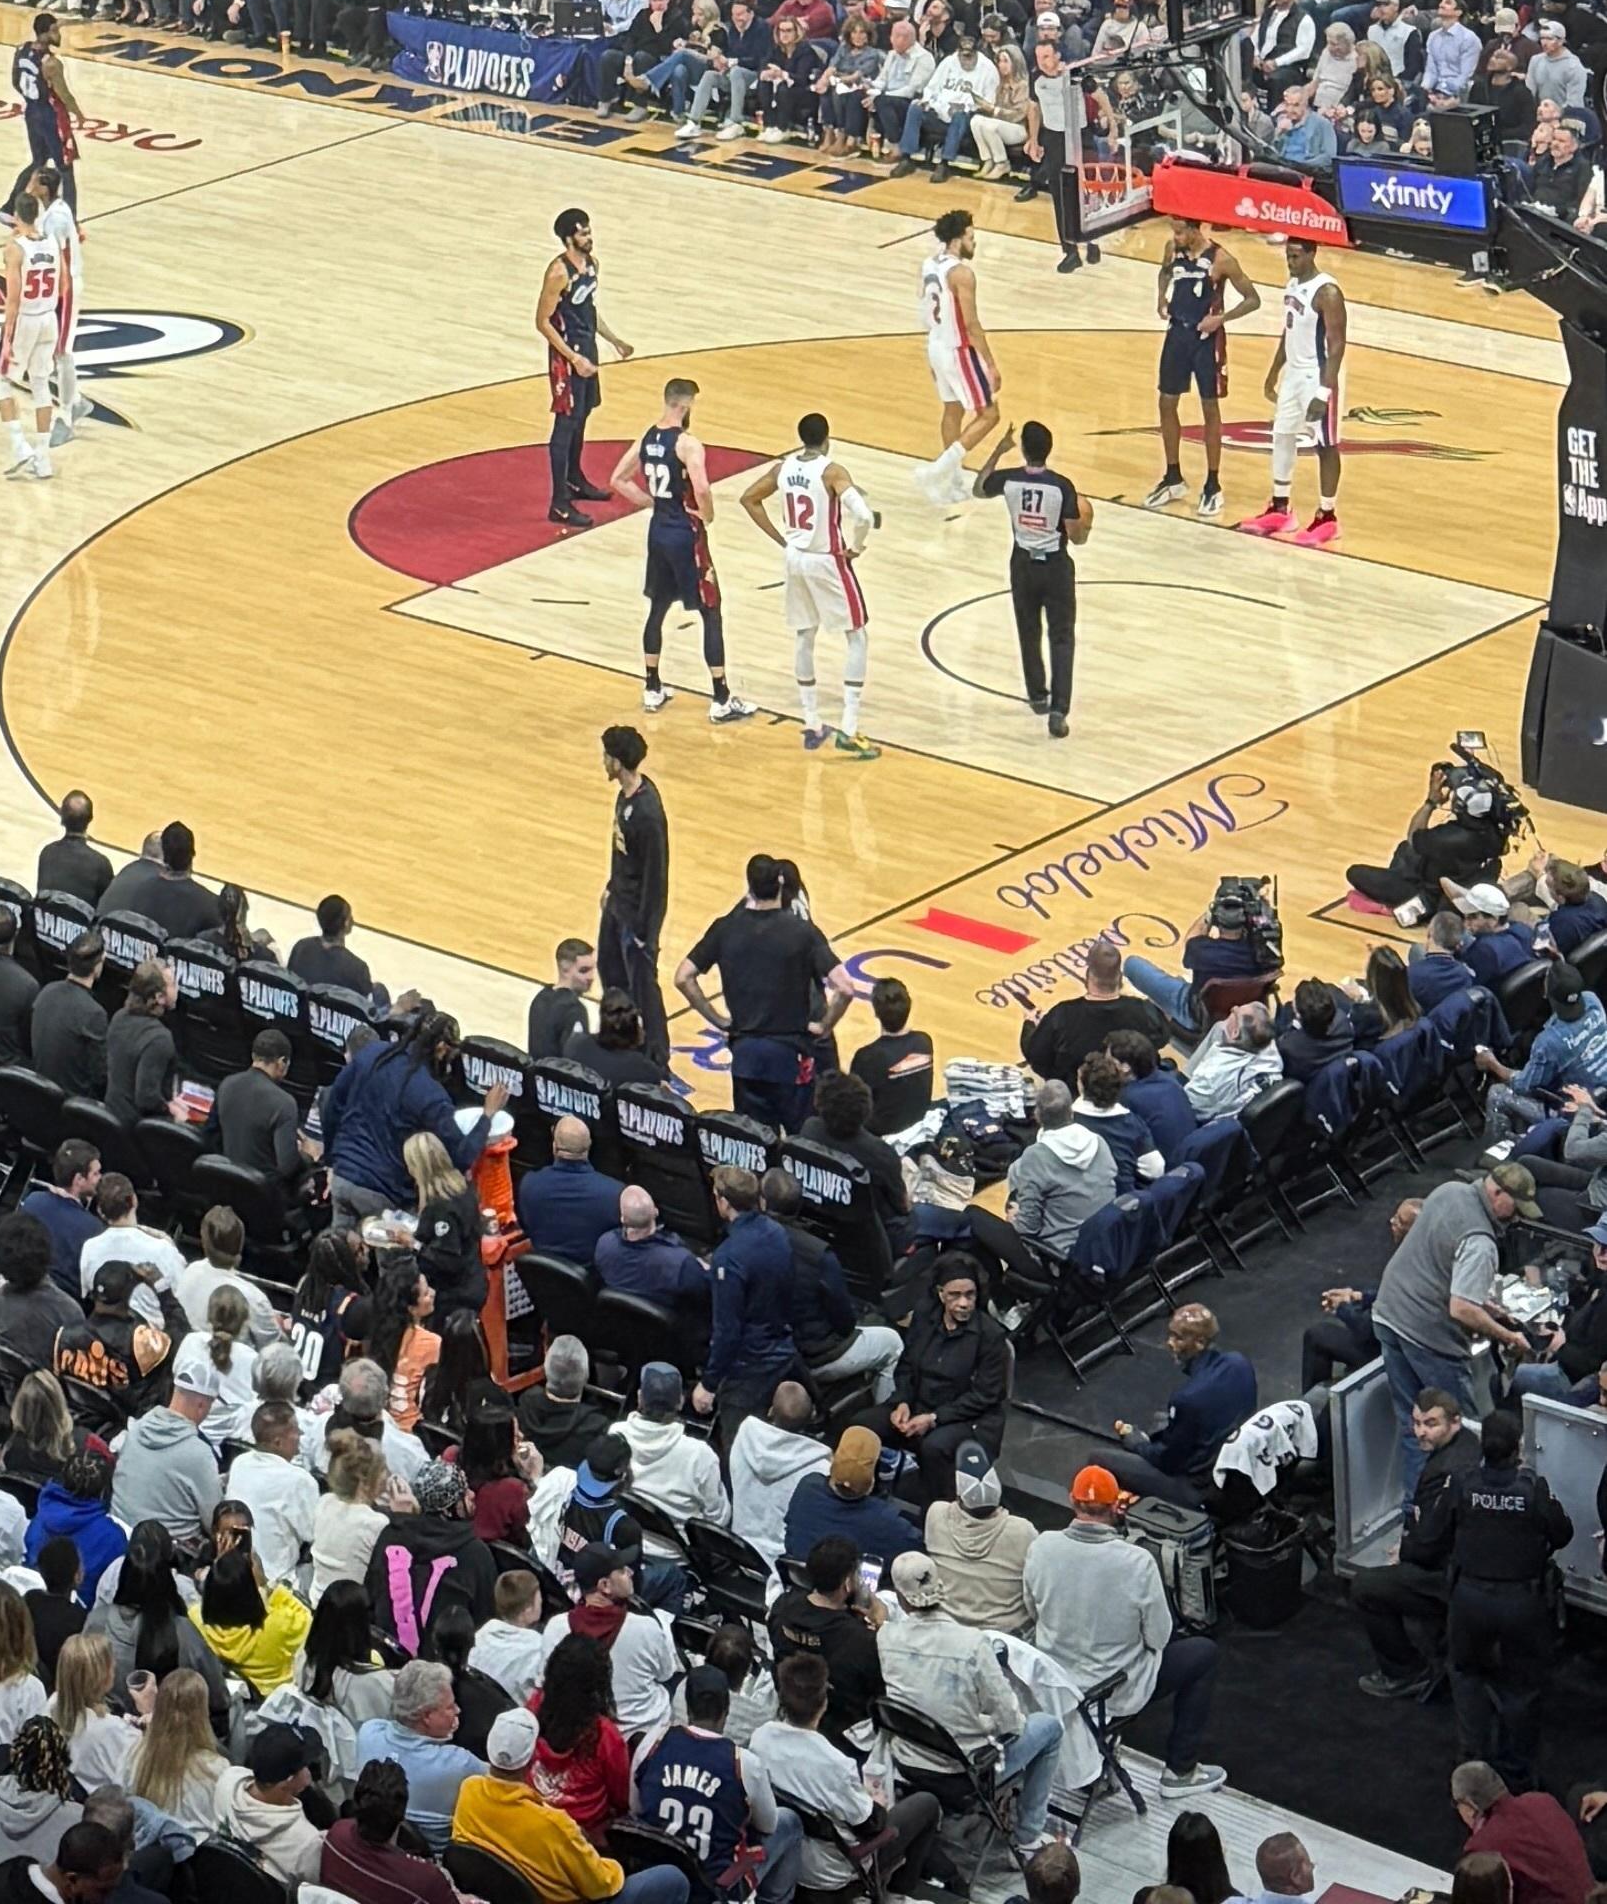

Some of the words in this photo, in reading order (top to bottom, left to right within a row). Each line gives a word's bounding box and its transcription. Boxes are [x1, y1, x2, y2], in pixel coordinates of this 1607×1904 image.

[444, 42, 536, 99] PLAYOFFS
[1371, 179, 1452, 215] xfinity
[24, 268, 55, 300] 55
[1567, 427, 1596, 458] GET
[1569, 456, 1599, 488] THE
[786, 494, 815, 530] 12
[629, 1100, 684, 1145] PLAYOFFS
[1471, 1492, 1525, 1511] POLICE
[662, 1763, 722, 1798] JAMES
